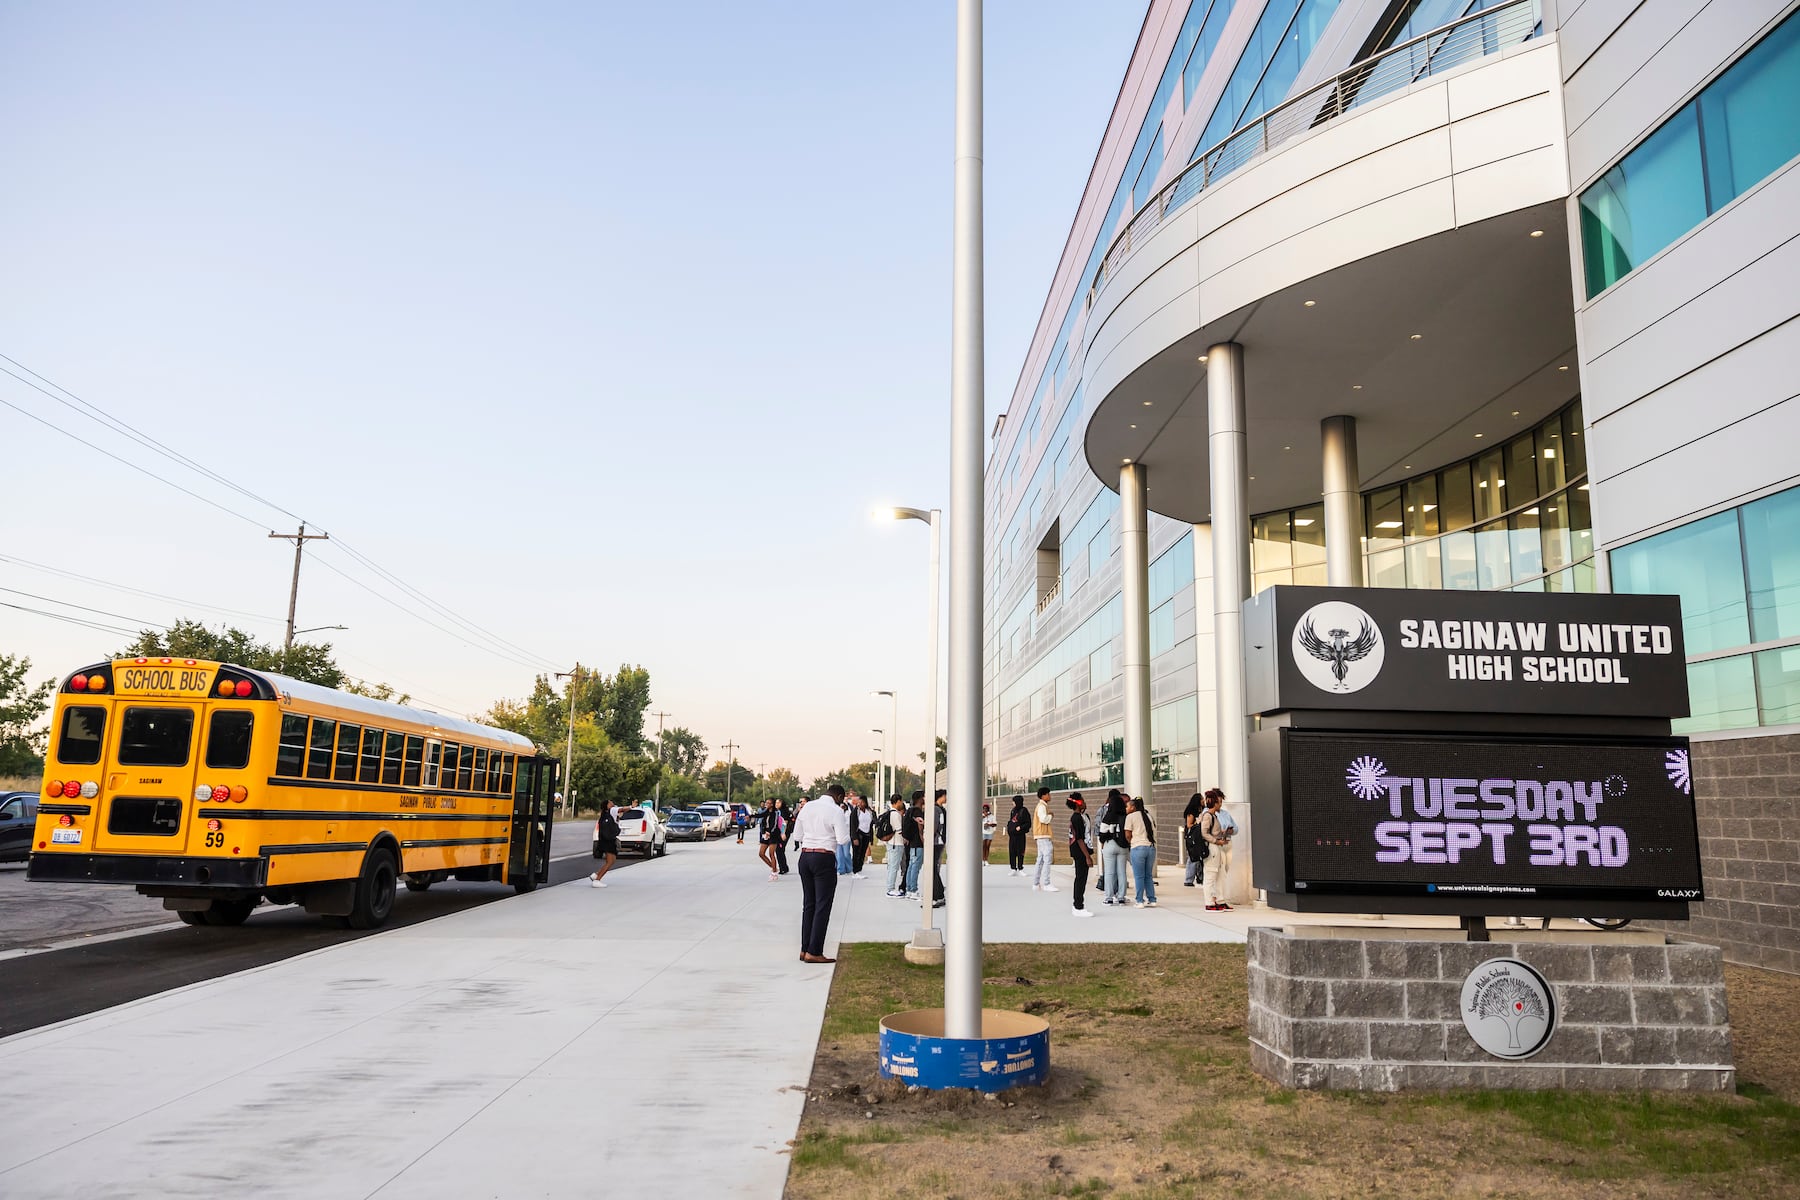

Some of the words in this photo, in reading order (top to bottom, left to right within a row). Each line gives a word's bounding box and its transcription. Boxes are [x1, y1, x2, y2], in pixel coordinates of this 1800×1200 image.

[1400, 619, 1546, 651] SAGINAW
[1558, 623, 1672, 654] UNITED
[124, 669, 176, 690] SCHOOL
[179, 671, 207, 691] BUS
[1448, 654, 1512, 681] HIGH
[1521, 656, 1629, 683] SCHOOL
[400, 795, 418, 808] SAGINAW
[423, 796, 437, 808] PUBLIC
[440, 797, 457, 809] SCHOOLS
[1380, 776, 1603, 822] TUESDAY
[205, 832, 224, 848] 59
[1374, 821, 1514, 864] SEPT
[1527, 824, 1629, 867] 3RD
[1437, 884, 1536, 894] www.universalsignsystems.com
[1474, 976, 1491, 990] Public
[1488, 967, 1511, 979] Schools
